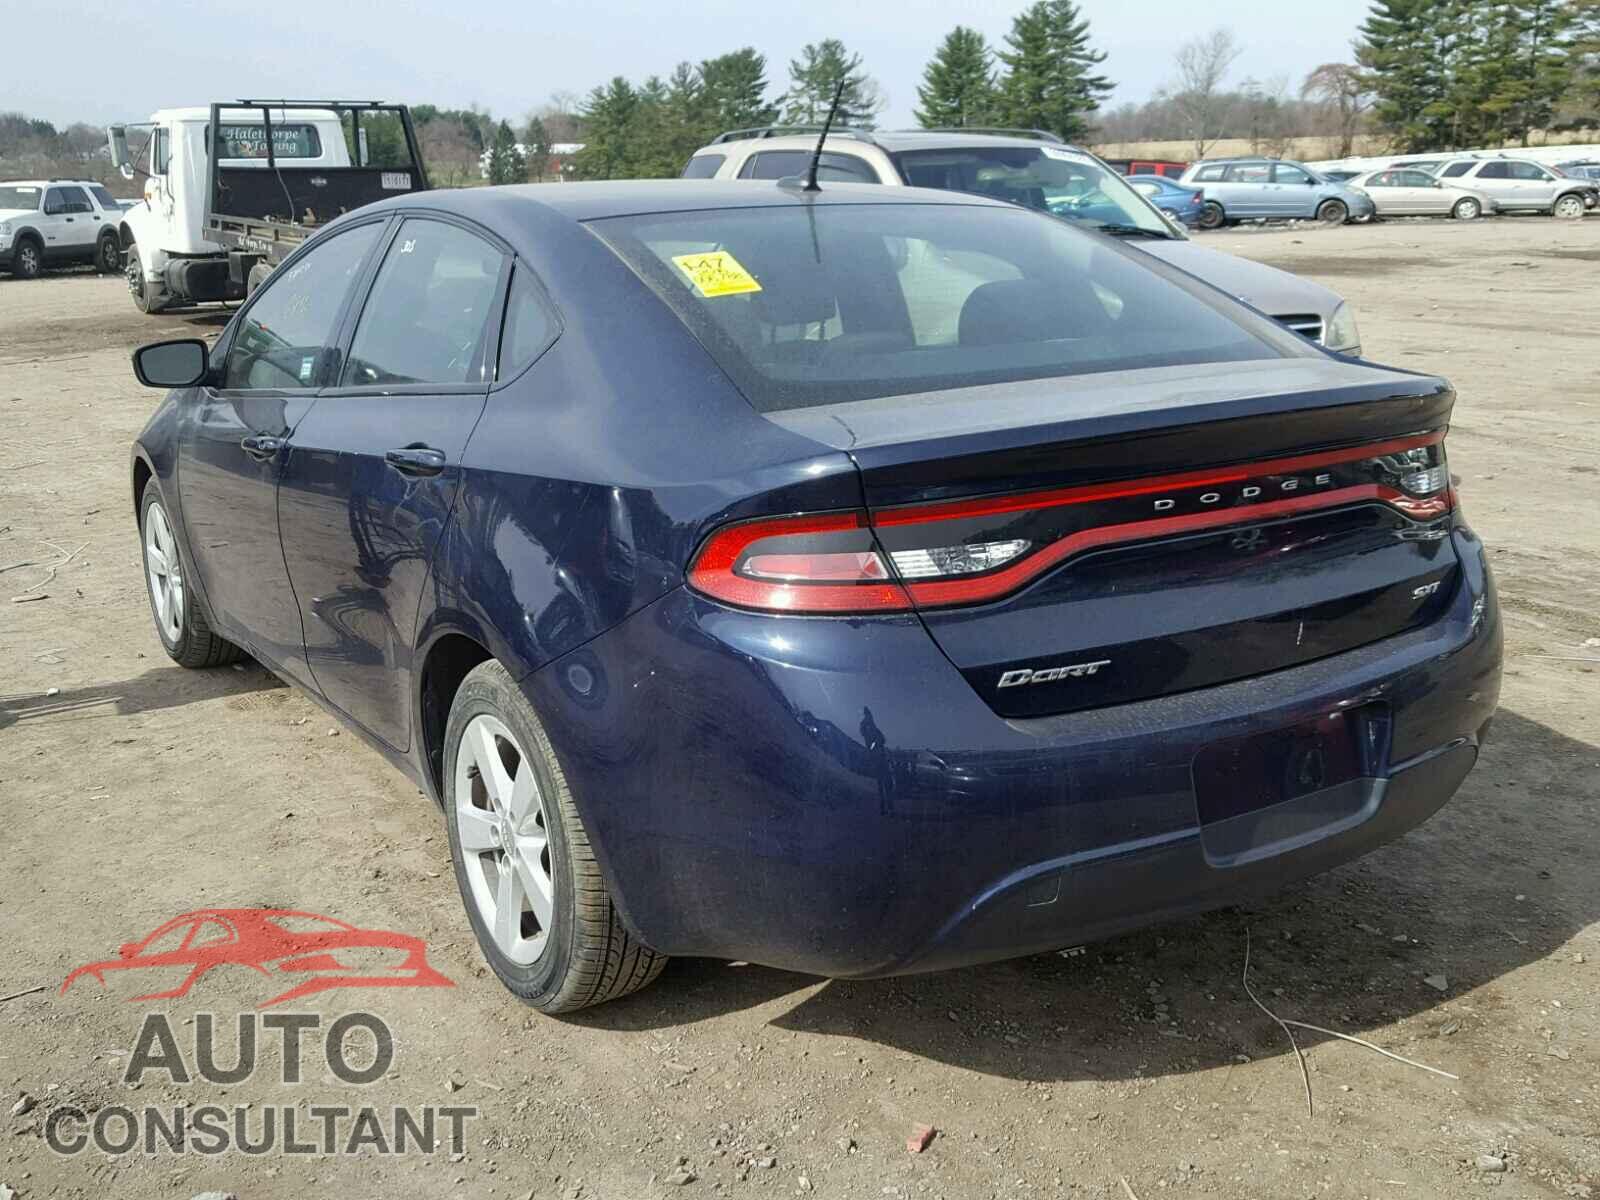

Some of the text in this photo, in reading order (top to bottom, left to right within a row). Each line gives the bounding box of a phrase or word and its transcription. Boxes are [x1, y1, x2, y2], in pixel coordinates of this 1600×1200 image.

[226, 127, 299, 143] Haletorpe
[252, 140, 297, 153] Toing
[1153, 473, 1331, 511] DODGE
[1412, 581, 1441, 600] SXT
